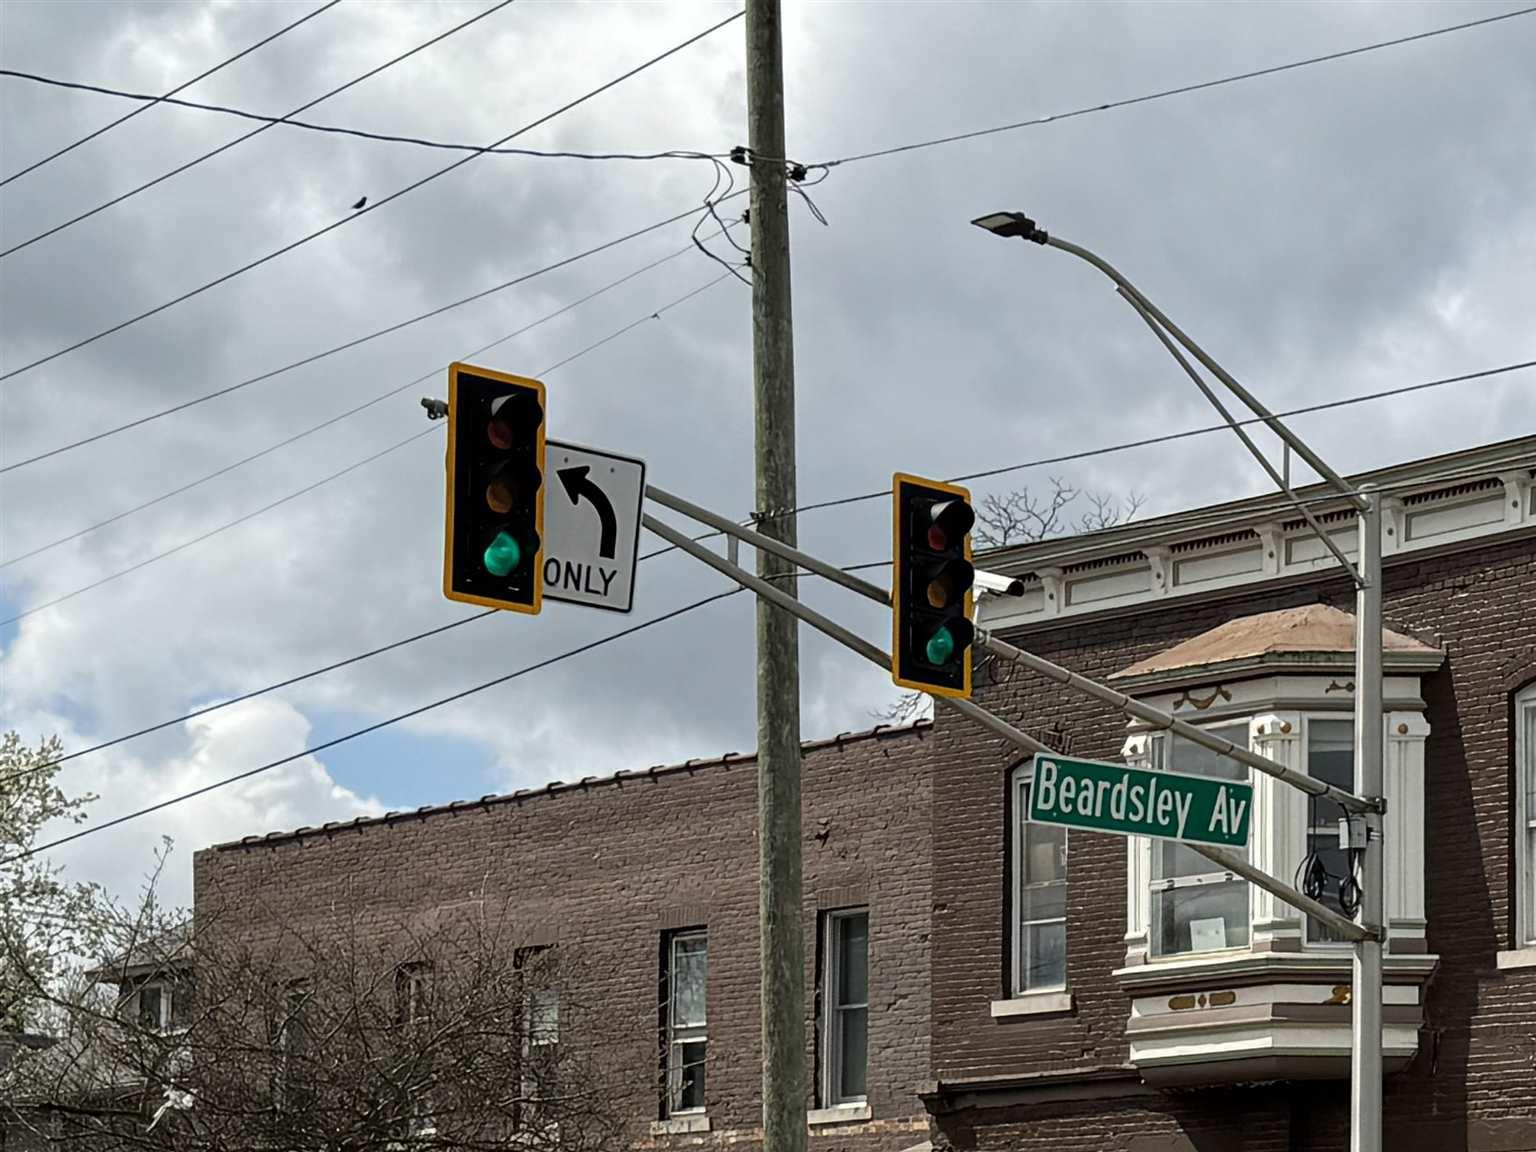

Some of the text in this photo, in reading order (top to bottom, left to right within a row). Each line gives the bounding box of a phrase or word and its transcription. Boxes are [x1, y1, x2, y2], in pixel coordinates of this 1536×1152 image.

[543, 557, 617, 597] ONLY
[1037, 760, 1247, 839] Beardsley Av
